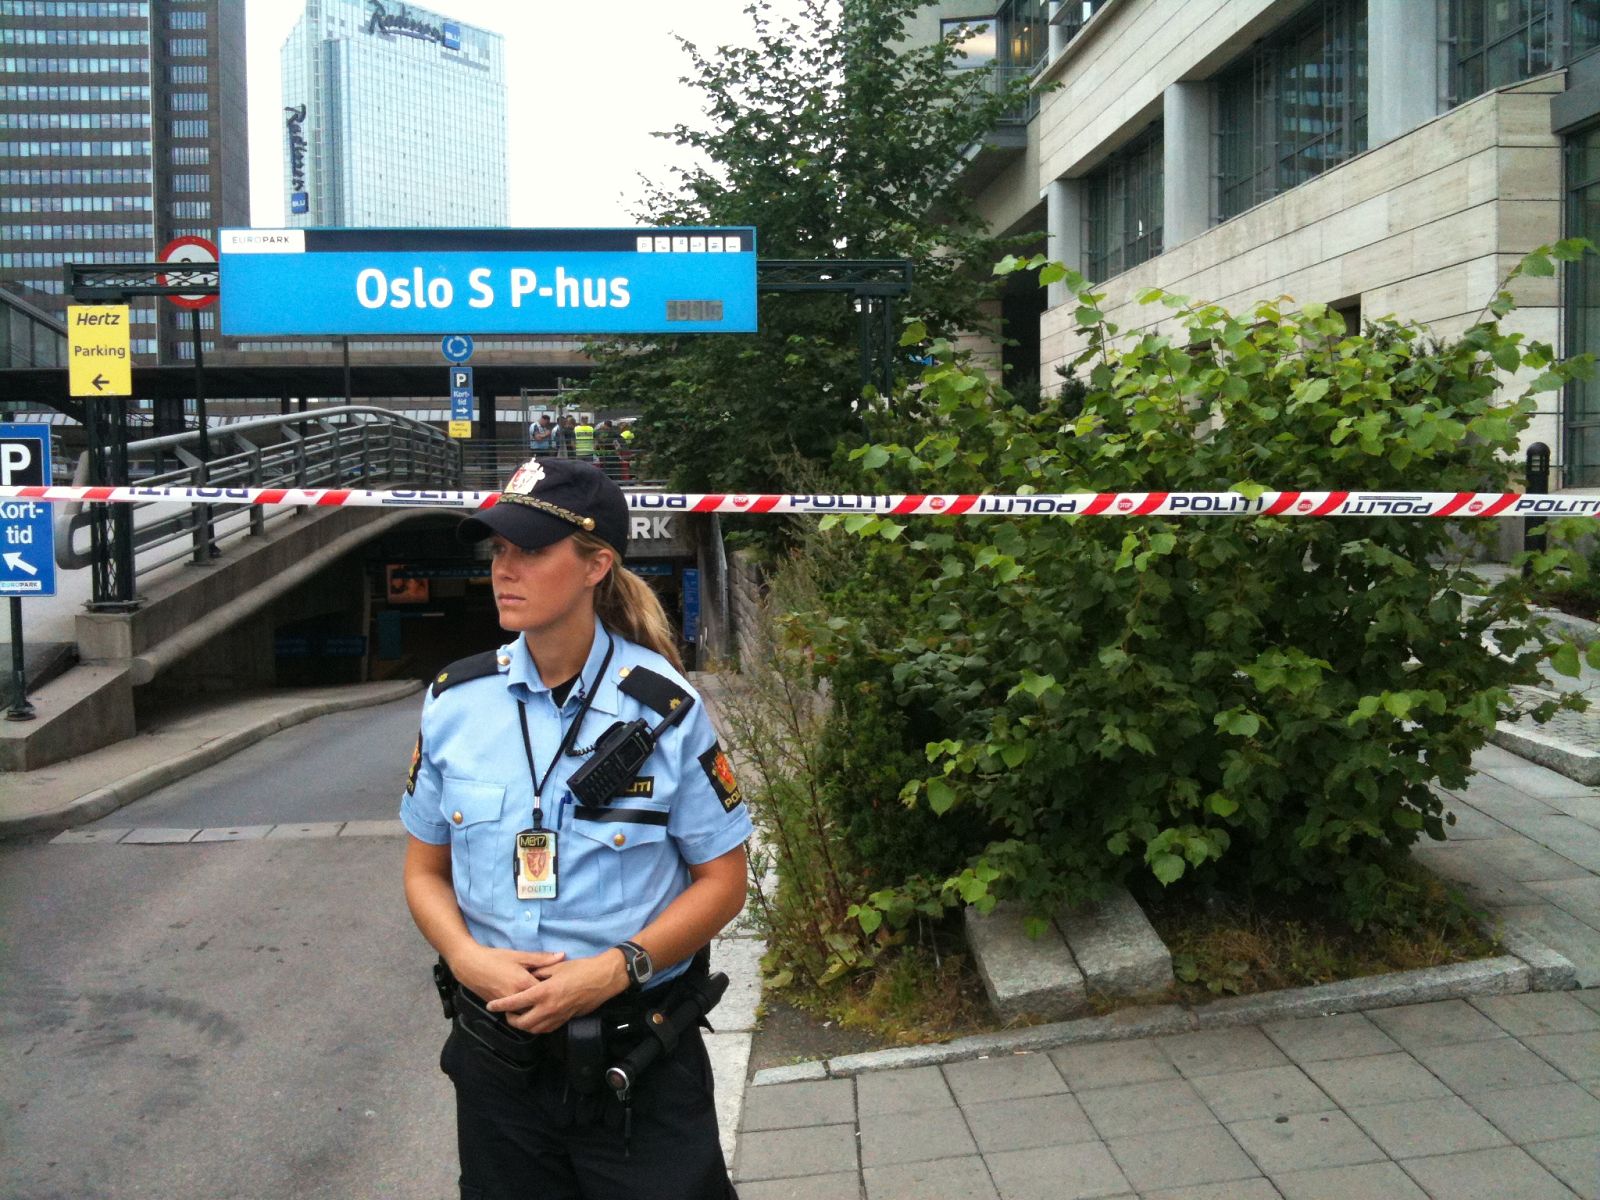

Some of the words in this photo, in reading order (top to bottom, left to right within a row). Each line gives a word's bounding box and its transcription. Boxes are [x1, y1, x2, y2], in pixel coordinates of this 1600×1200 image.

[231, 236, 291, 244] EUROPARK
[356, 267, 453, 308] Oslo
[468, 268, 494, 308] S
[510, 266, 630, 308] P-hus
[76, 312, 120, 326] Hertz
[74, 345, 126, 359] Parking
[456, 373, 467, 387] P
[0, 443, 32, 486] P
[979, 499, 1077, 512] POLITI
[1169, 496, 1264, 511] POLITI
[1341, 502, 1432, 514] POLITI
[1514, 499, 1600, 512] POLITI
[6, 525, 33, 544] tid
[521, 885, 552, 894] POLITI
